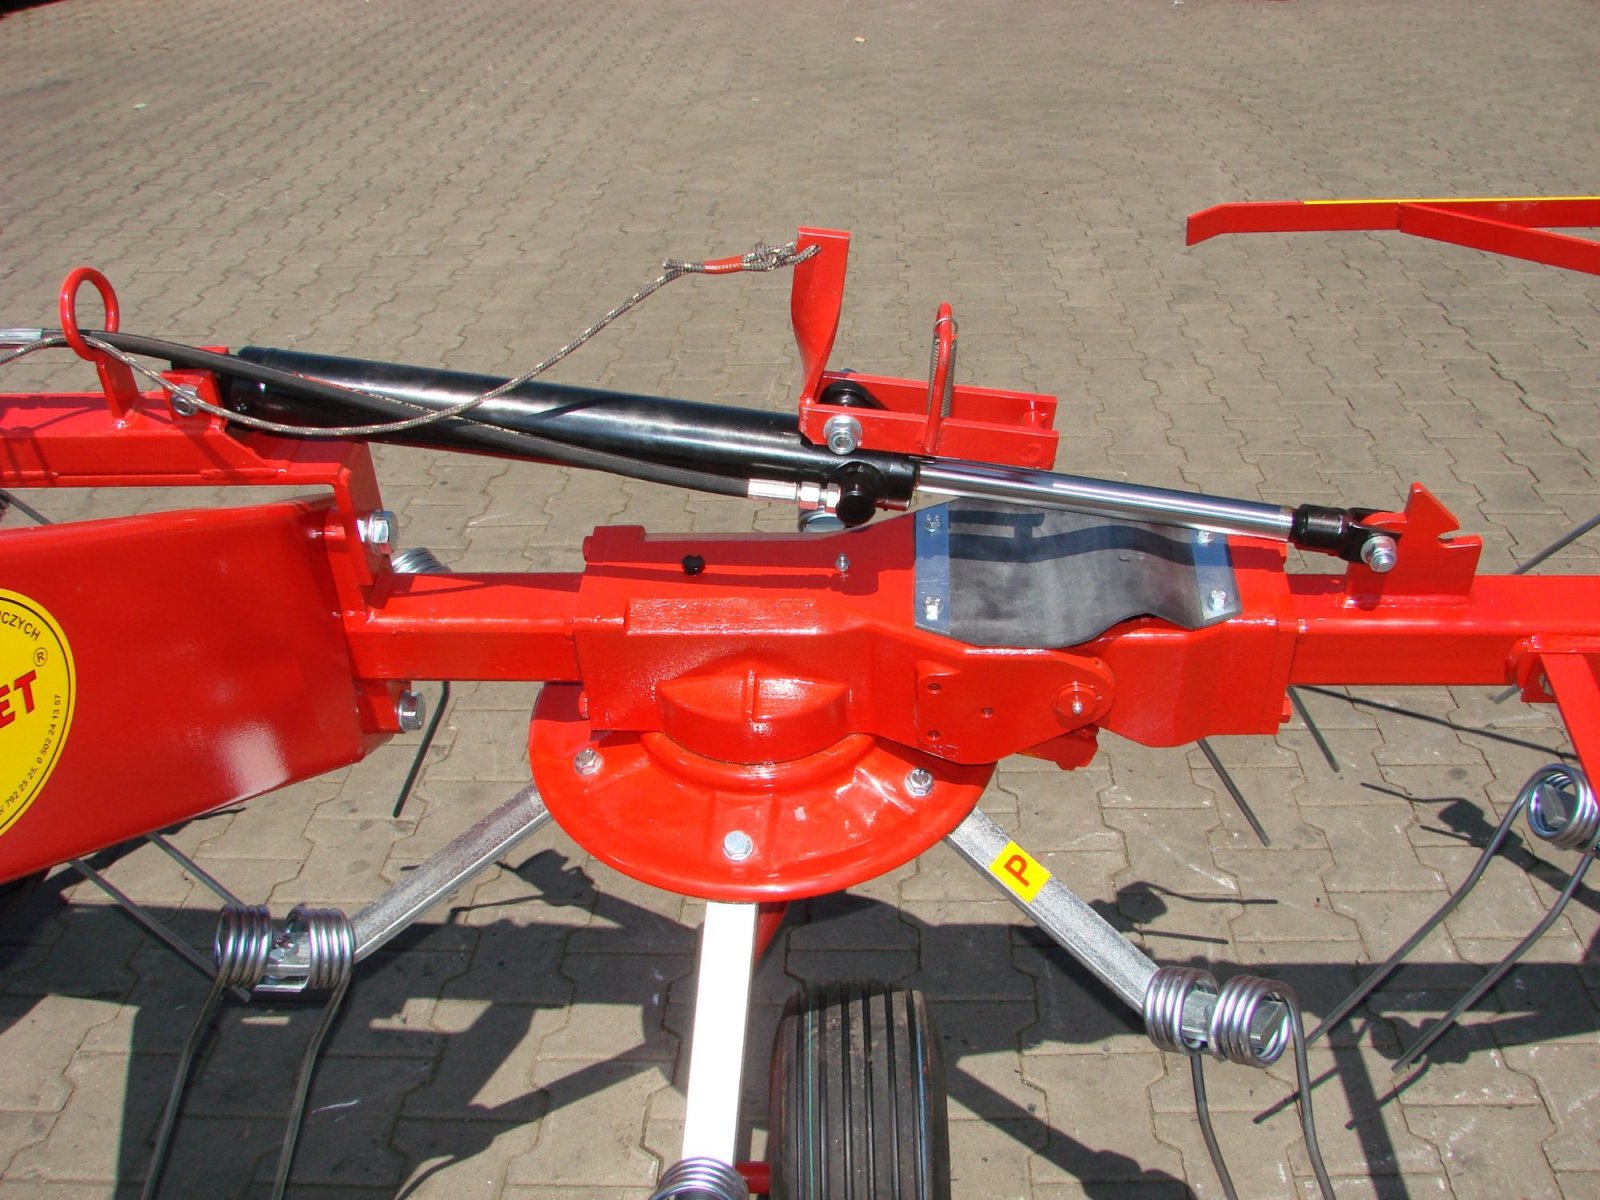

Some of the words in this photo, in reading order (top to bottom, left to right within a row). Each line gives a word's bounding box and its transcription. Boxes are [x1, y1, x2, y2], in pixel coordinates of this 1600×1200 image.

[0, 611, 41, 641] CZYCH
[54, 694, 61, 706] 57
[52, 709, 60, 719] 13
[48, 724, 56, 736] 24
[41, 738, 52, 755] 502
[37, 756, 43, 764] 0
[19, 779, 28, 792] 25
[5, 791, 19, 807] 792
[1004, 854, 1030, 887] P
